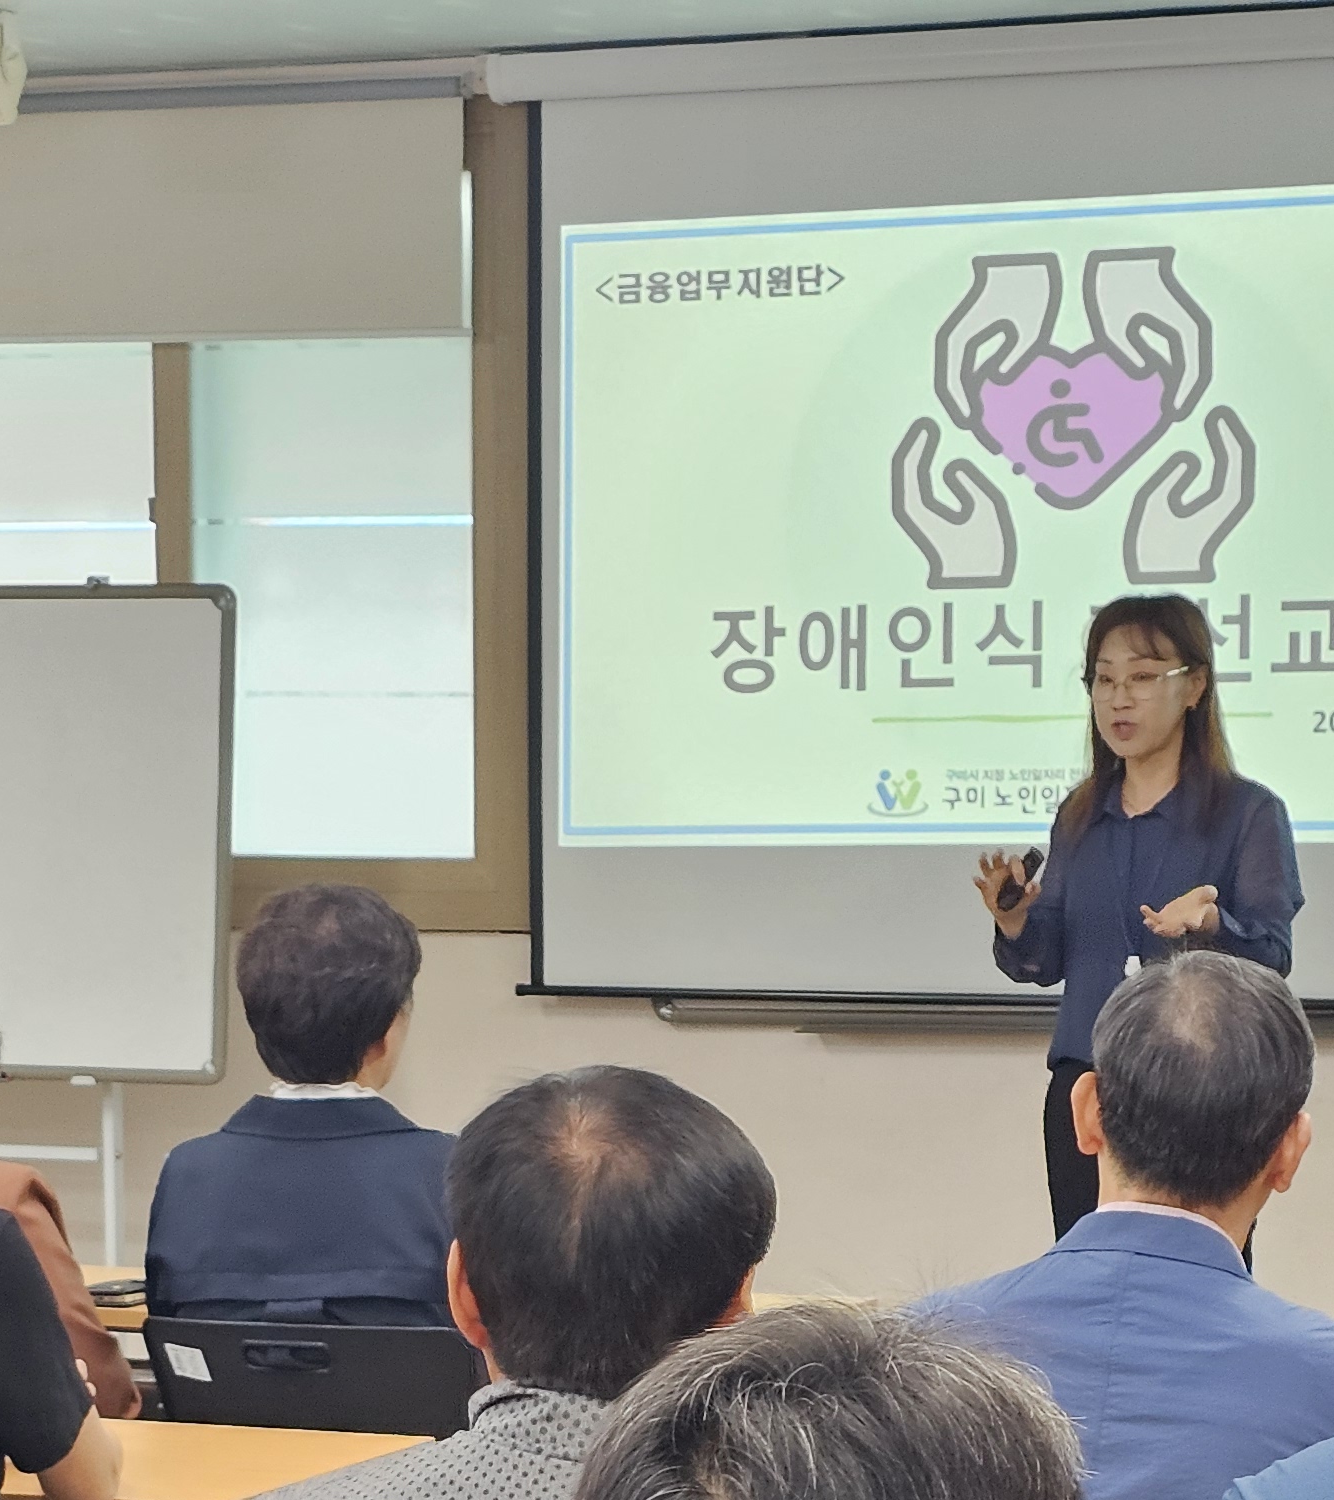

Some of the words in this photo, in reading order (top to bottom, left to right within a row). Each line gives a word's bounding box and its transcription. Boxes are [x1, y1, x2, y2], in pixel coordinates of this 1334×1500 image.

[596, 264, 845, 304] <금융업무지원단>
[710, 599, 1044, 693] 장애인식
[942, 785, 985, 811] 구미
[993, 784, 1071, 815] 노인일
